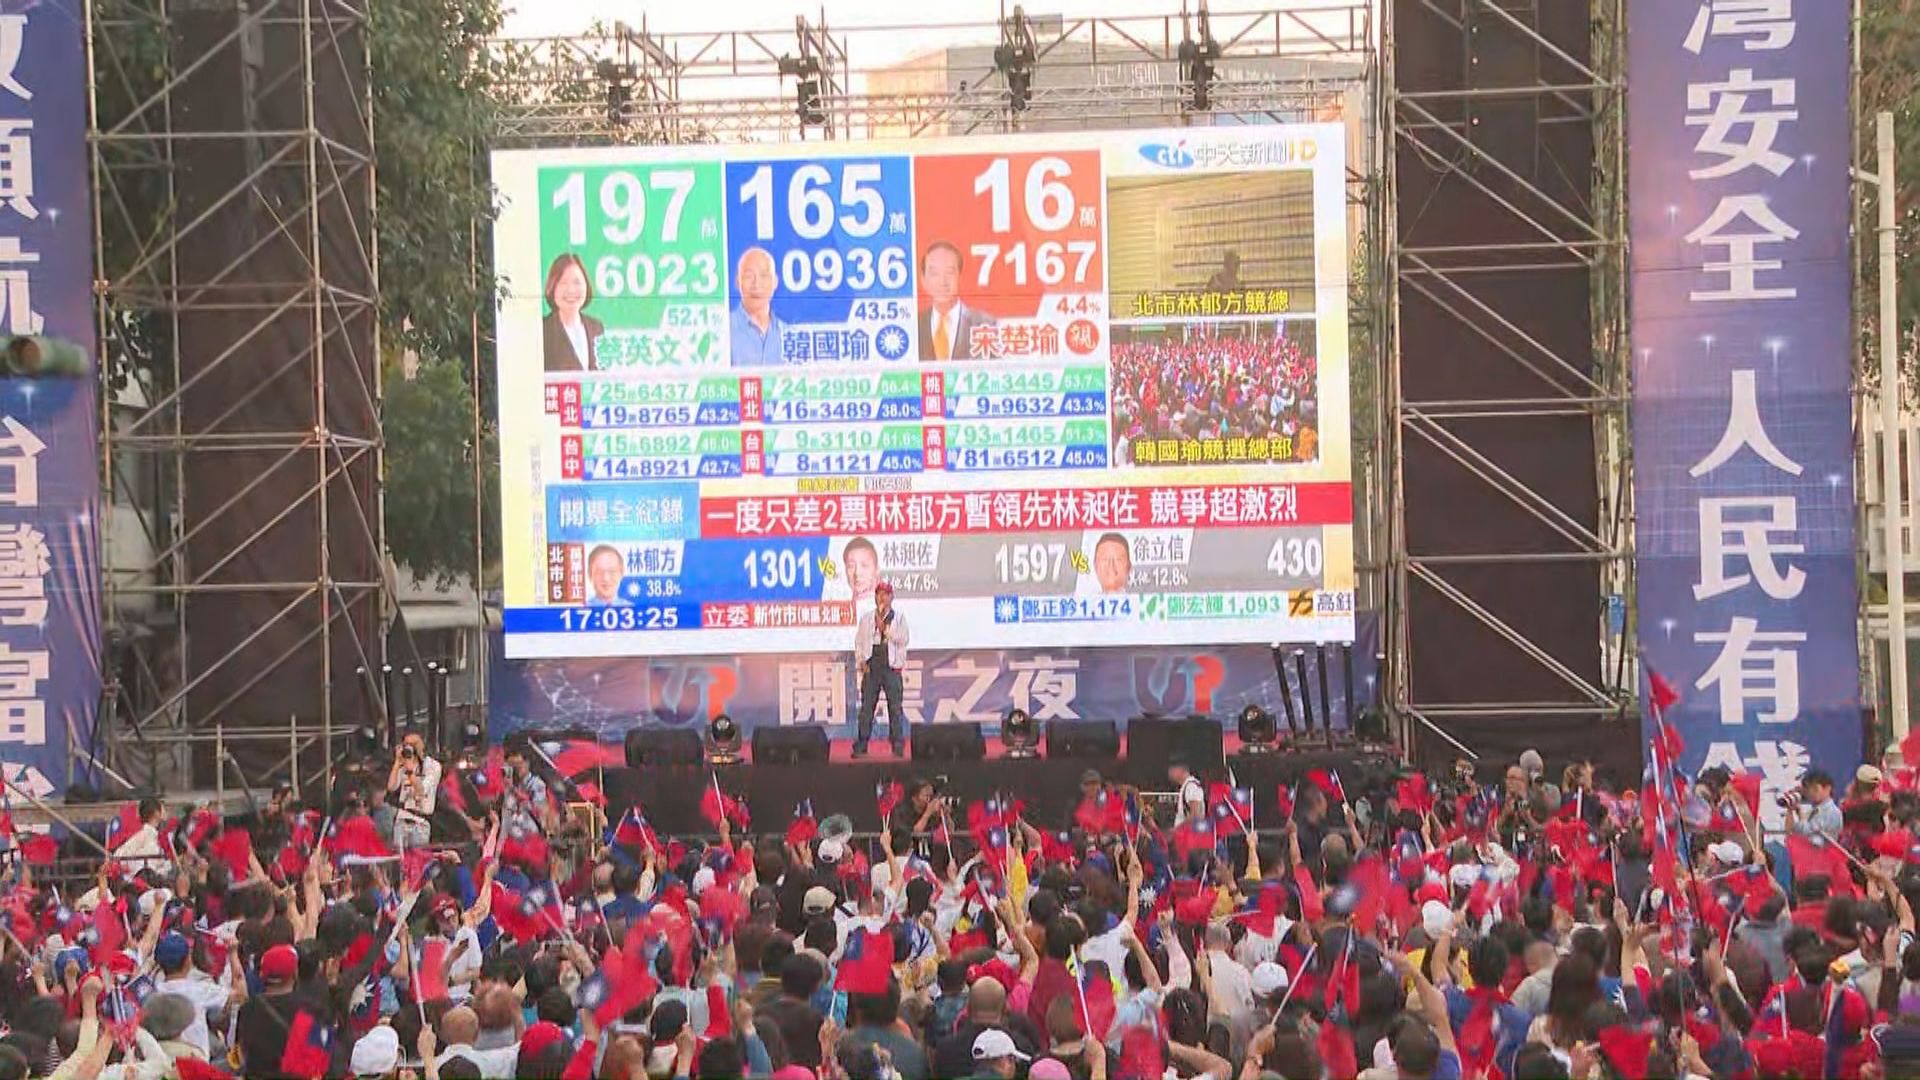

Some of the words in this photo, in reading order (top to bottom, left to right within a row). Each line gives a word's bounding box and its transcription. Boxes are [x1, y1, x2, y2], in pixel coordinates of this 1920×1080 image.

[596, 251, 718, 297] 6023
[783, 247, 908, 293] 0936
[970, 241, 1097, 287] 7167
[668, 306, 722, 327] 52.1%
[855, 301, 911, 320] 43.5%
[1057, 295, 1101, 315] 4.4%
[596, 334, 681, 368] 蔡英文
[782, 329, 870, 362] 韓國瑜
[969, 323, 1059, 359] 宋楚瑜
[563, 385, 578, 423] 台北
[564, 438, 580, 476] 台中
[1135, 437, 1292, 463] 韓國瑜競選總部
[1151, 485, 1299, 525] 競爭超激烈
[627, 547, 676, 573] 林郁方
[882, 539, 934, 568] 林昶佐
[994, 542, 1066, 584] 1597
[1133, 535, 1184, 562] 徐立信
[1266, 537, 1323, 577] 430
[743, 547, 812, 589] 1301
[647, 578, 682, 598] 38.8%
[559, 607, 679, 630] 17:03:25
[703, 605, 750, 628] 立委
